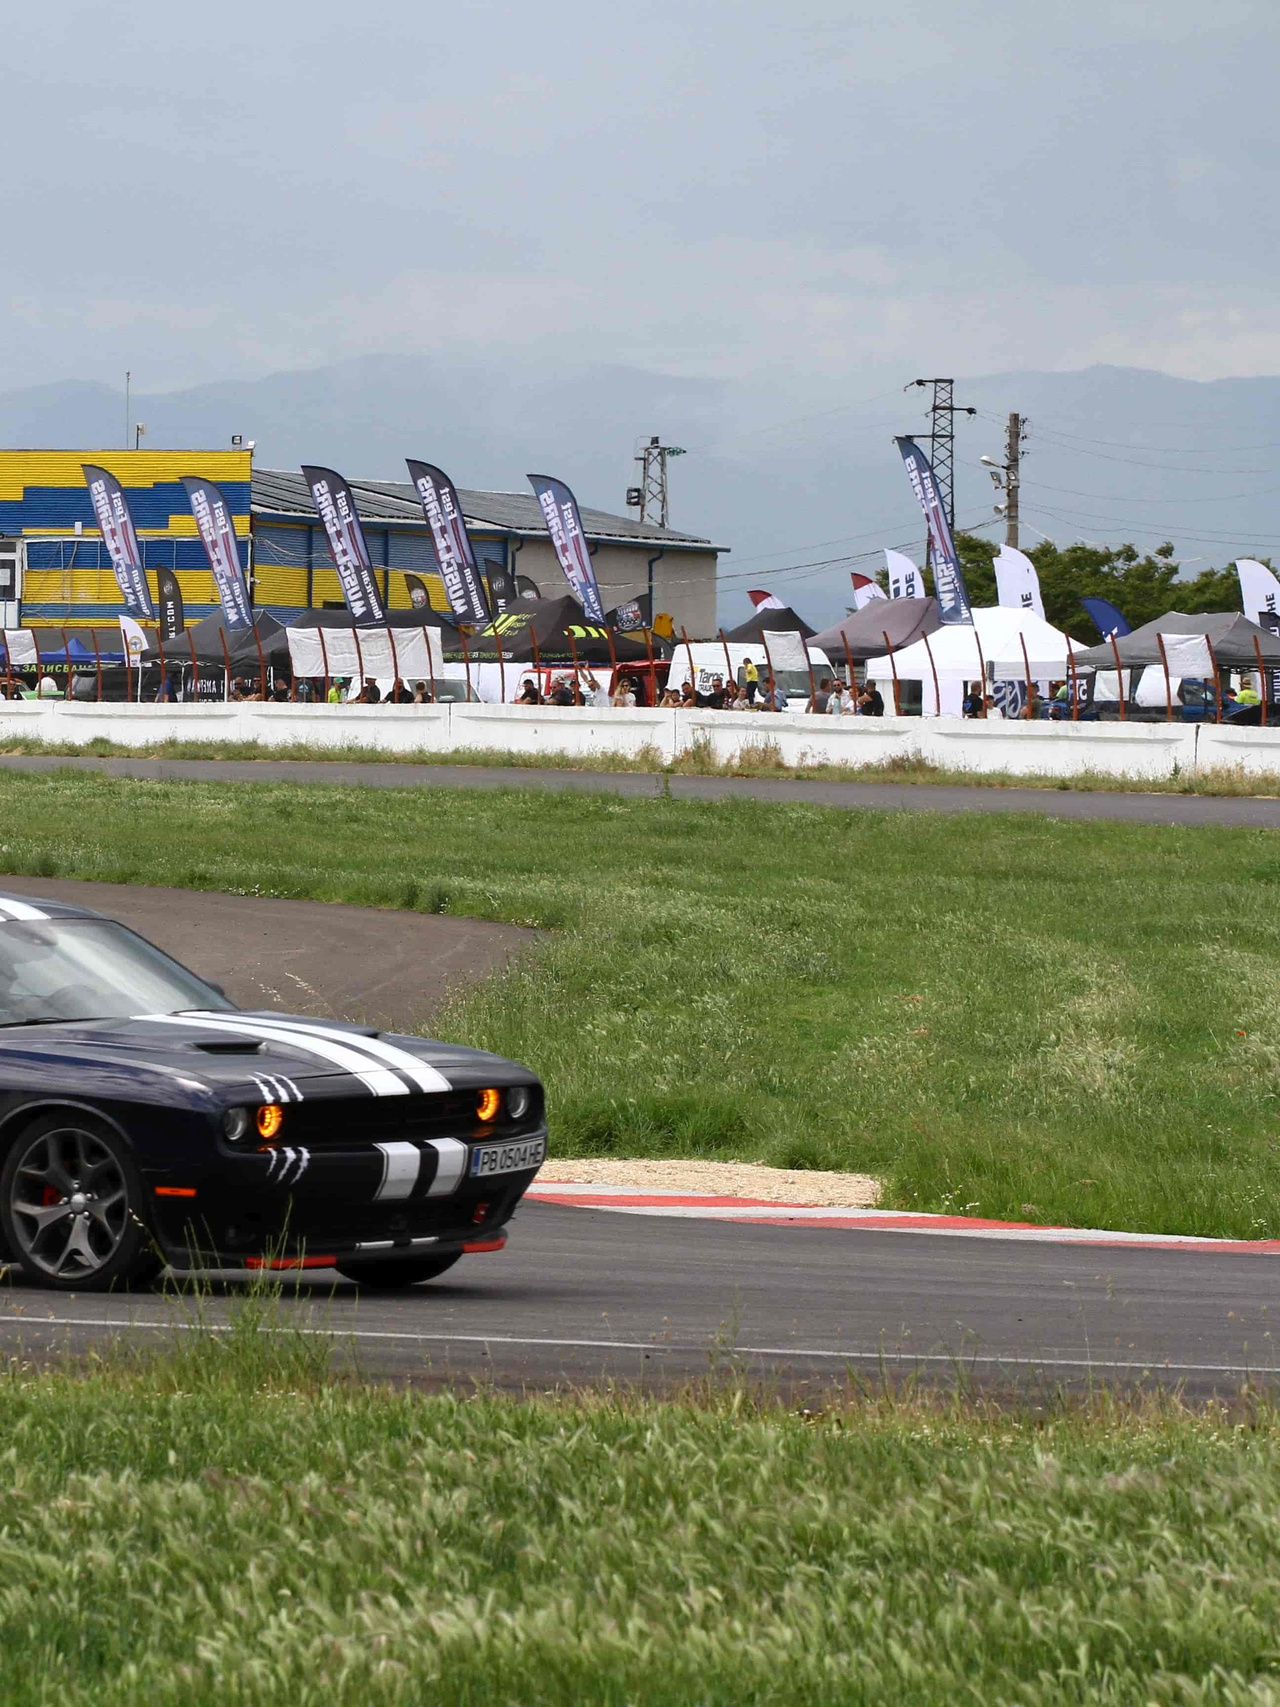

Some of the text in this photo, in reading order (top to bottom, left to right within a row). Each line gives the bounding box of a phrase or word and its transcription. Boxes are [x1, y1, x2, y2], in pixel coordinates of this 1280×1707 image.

[481, 1142, 543, 1172] PB 0504 HE
